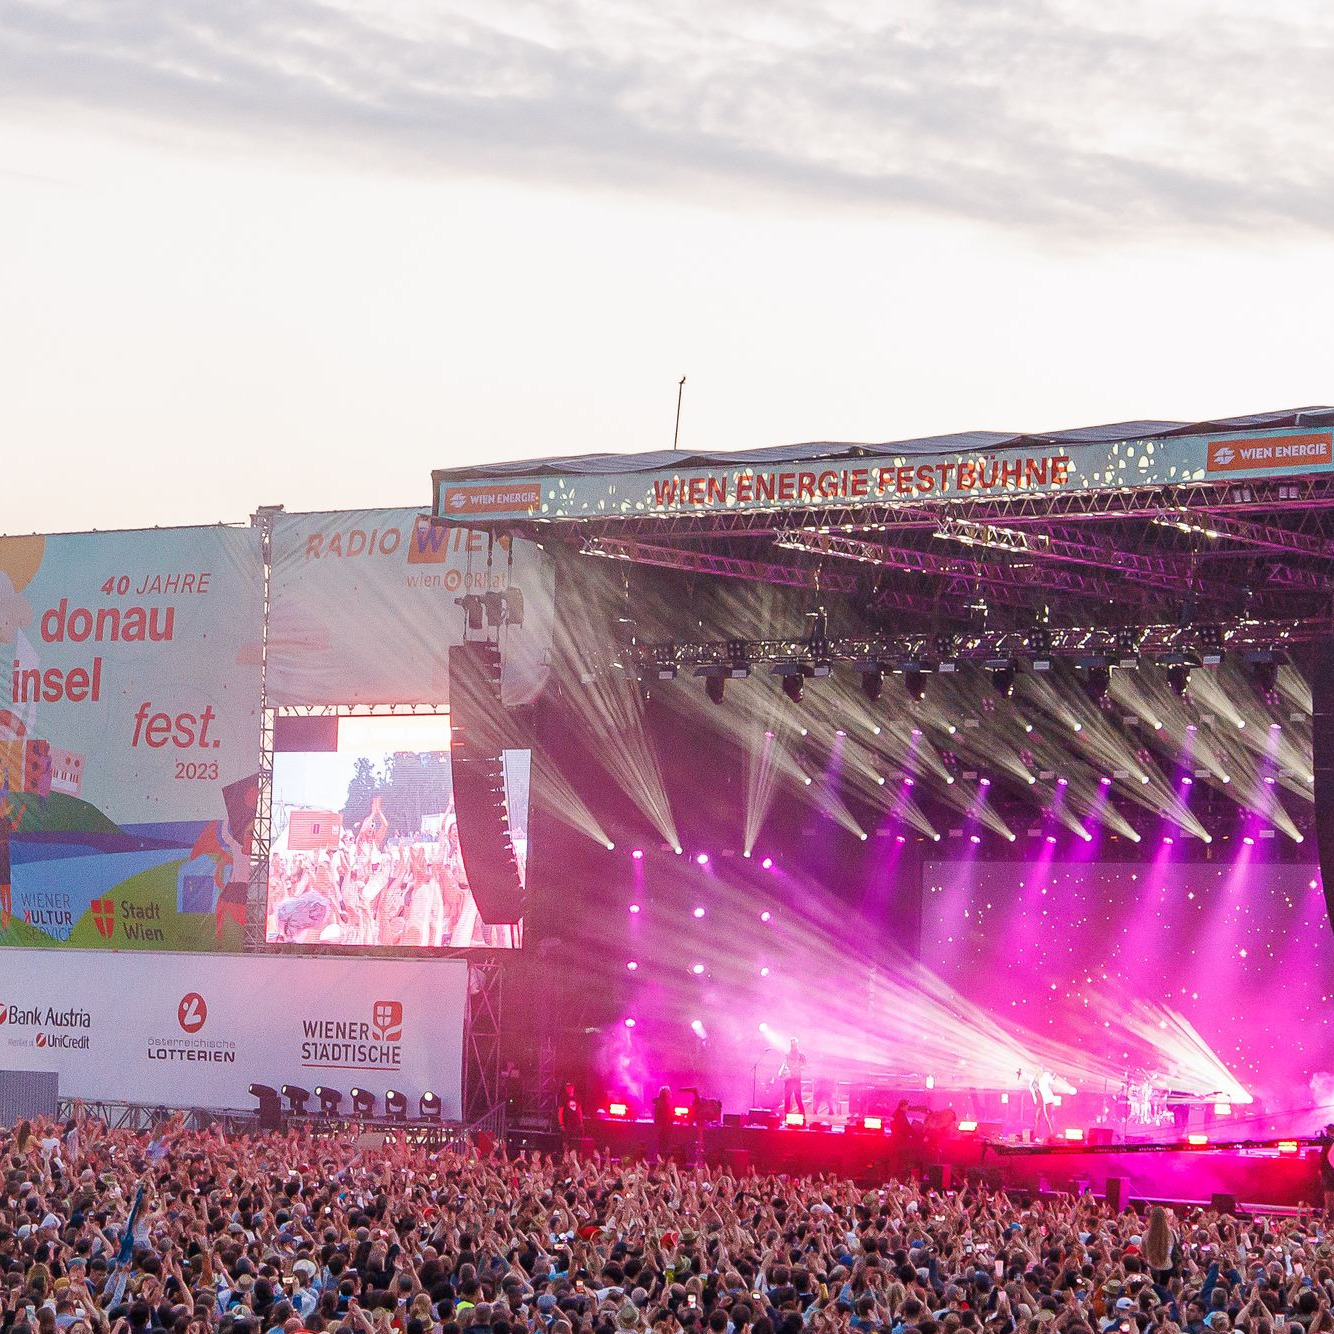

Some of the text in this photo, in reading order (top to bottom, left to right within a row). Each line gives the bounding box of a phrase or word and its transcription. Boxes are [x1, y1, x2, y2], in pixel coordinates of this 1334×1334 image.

[1239, 442, 1328, 460] WIEN ENERGIE
[653, 455, 1069, 507] WIEN ENERGIE FESTBÜHNE
[470, 492, 536, 504] WIEN ENERGIE
[304, 527, 402, 561] RADIO
[100, 573, 212, 596] 40 JAHRE
[40, 598, 175, 643] donau
[12, 656, 102, 703] insel
[131, 701, 221, 748] fest.
[174, 762, 219, 780] 2023
[20, 892, 71, 909] WIENER
[120, 900, 161, 921] Stadt
[23, 925, 73, 943] SERVICE
[123, 922, 164, 942] Wien
[8, 1005, 91, 1028] Bank Austria
[303, 1019, 370, 1042] WIENER
[47, 1034, 90, 1051] UniCredit
[148, 1036, 236, 1050] österreichische
[148, 1048, 236, 1063] LOTTERIEN
[301, 1042, 402, 1065] STÄDTISCHE
